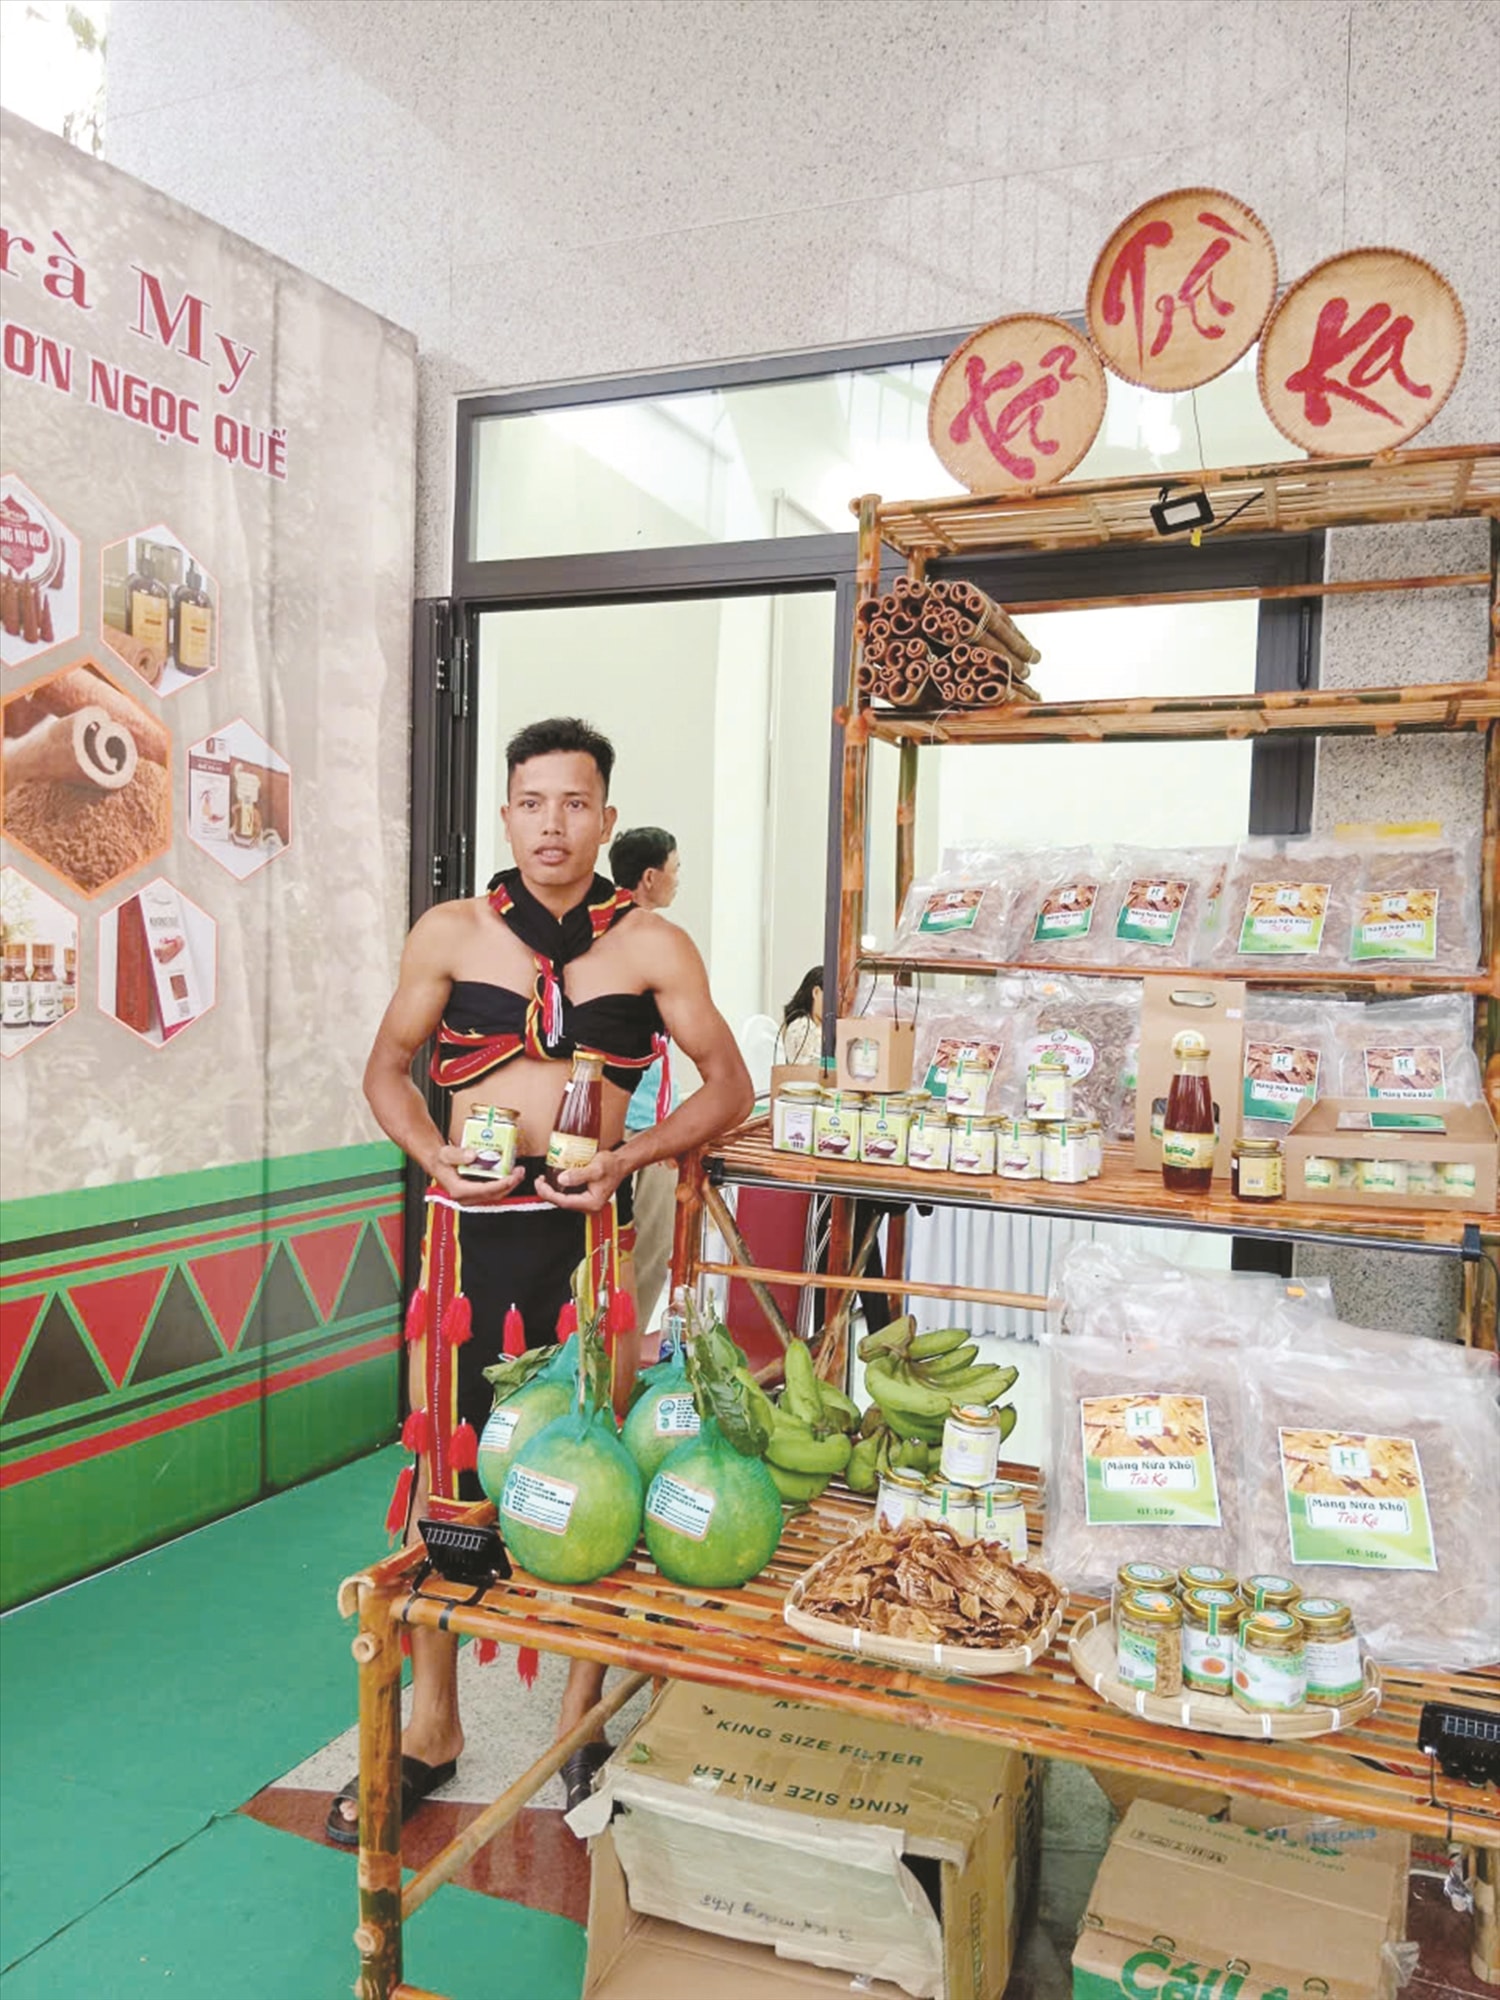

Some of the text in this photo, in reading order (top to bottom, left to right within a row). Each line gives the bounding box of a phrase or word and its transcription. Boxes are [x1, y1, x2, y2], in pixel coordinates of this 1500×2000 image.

[130, 264, 258, 393] My
[1285, 297, 1432, 427] Ka
[91, 360, 199, 444] NGỌC
[215, 414, 288, 480] QUẾ
[1169, 1460, 1192, 1470] Khô
[1379, 1501, 1403, 1512] Khô
[716, 1719, 924, 1767] KING SIZE FILTER
[693, 1763, 909, 1816] KING SIZE FILTER
